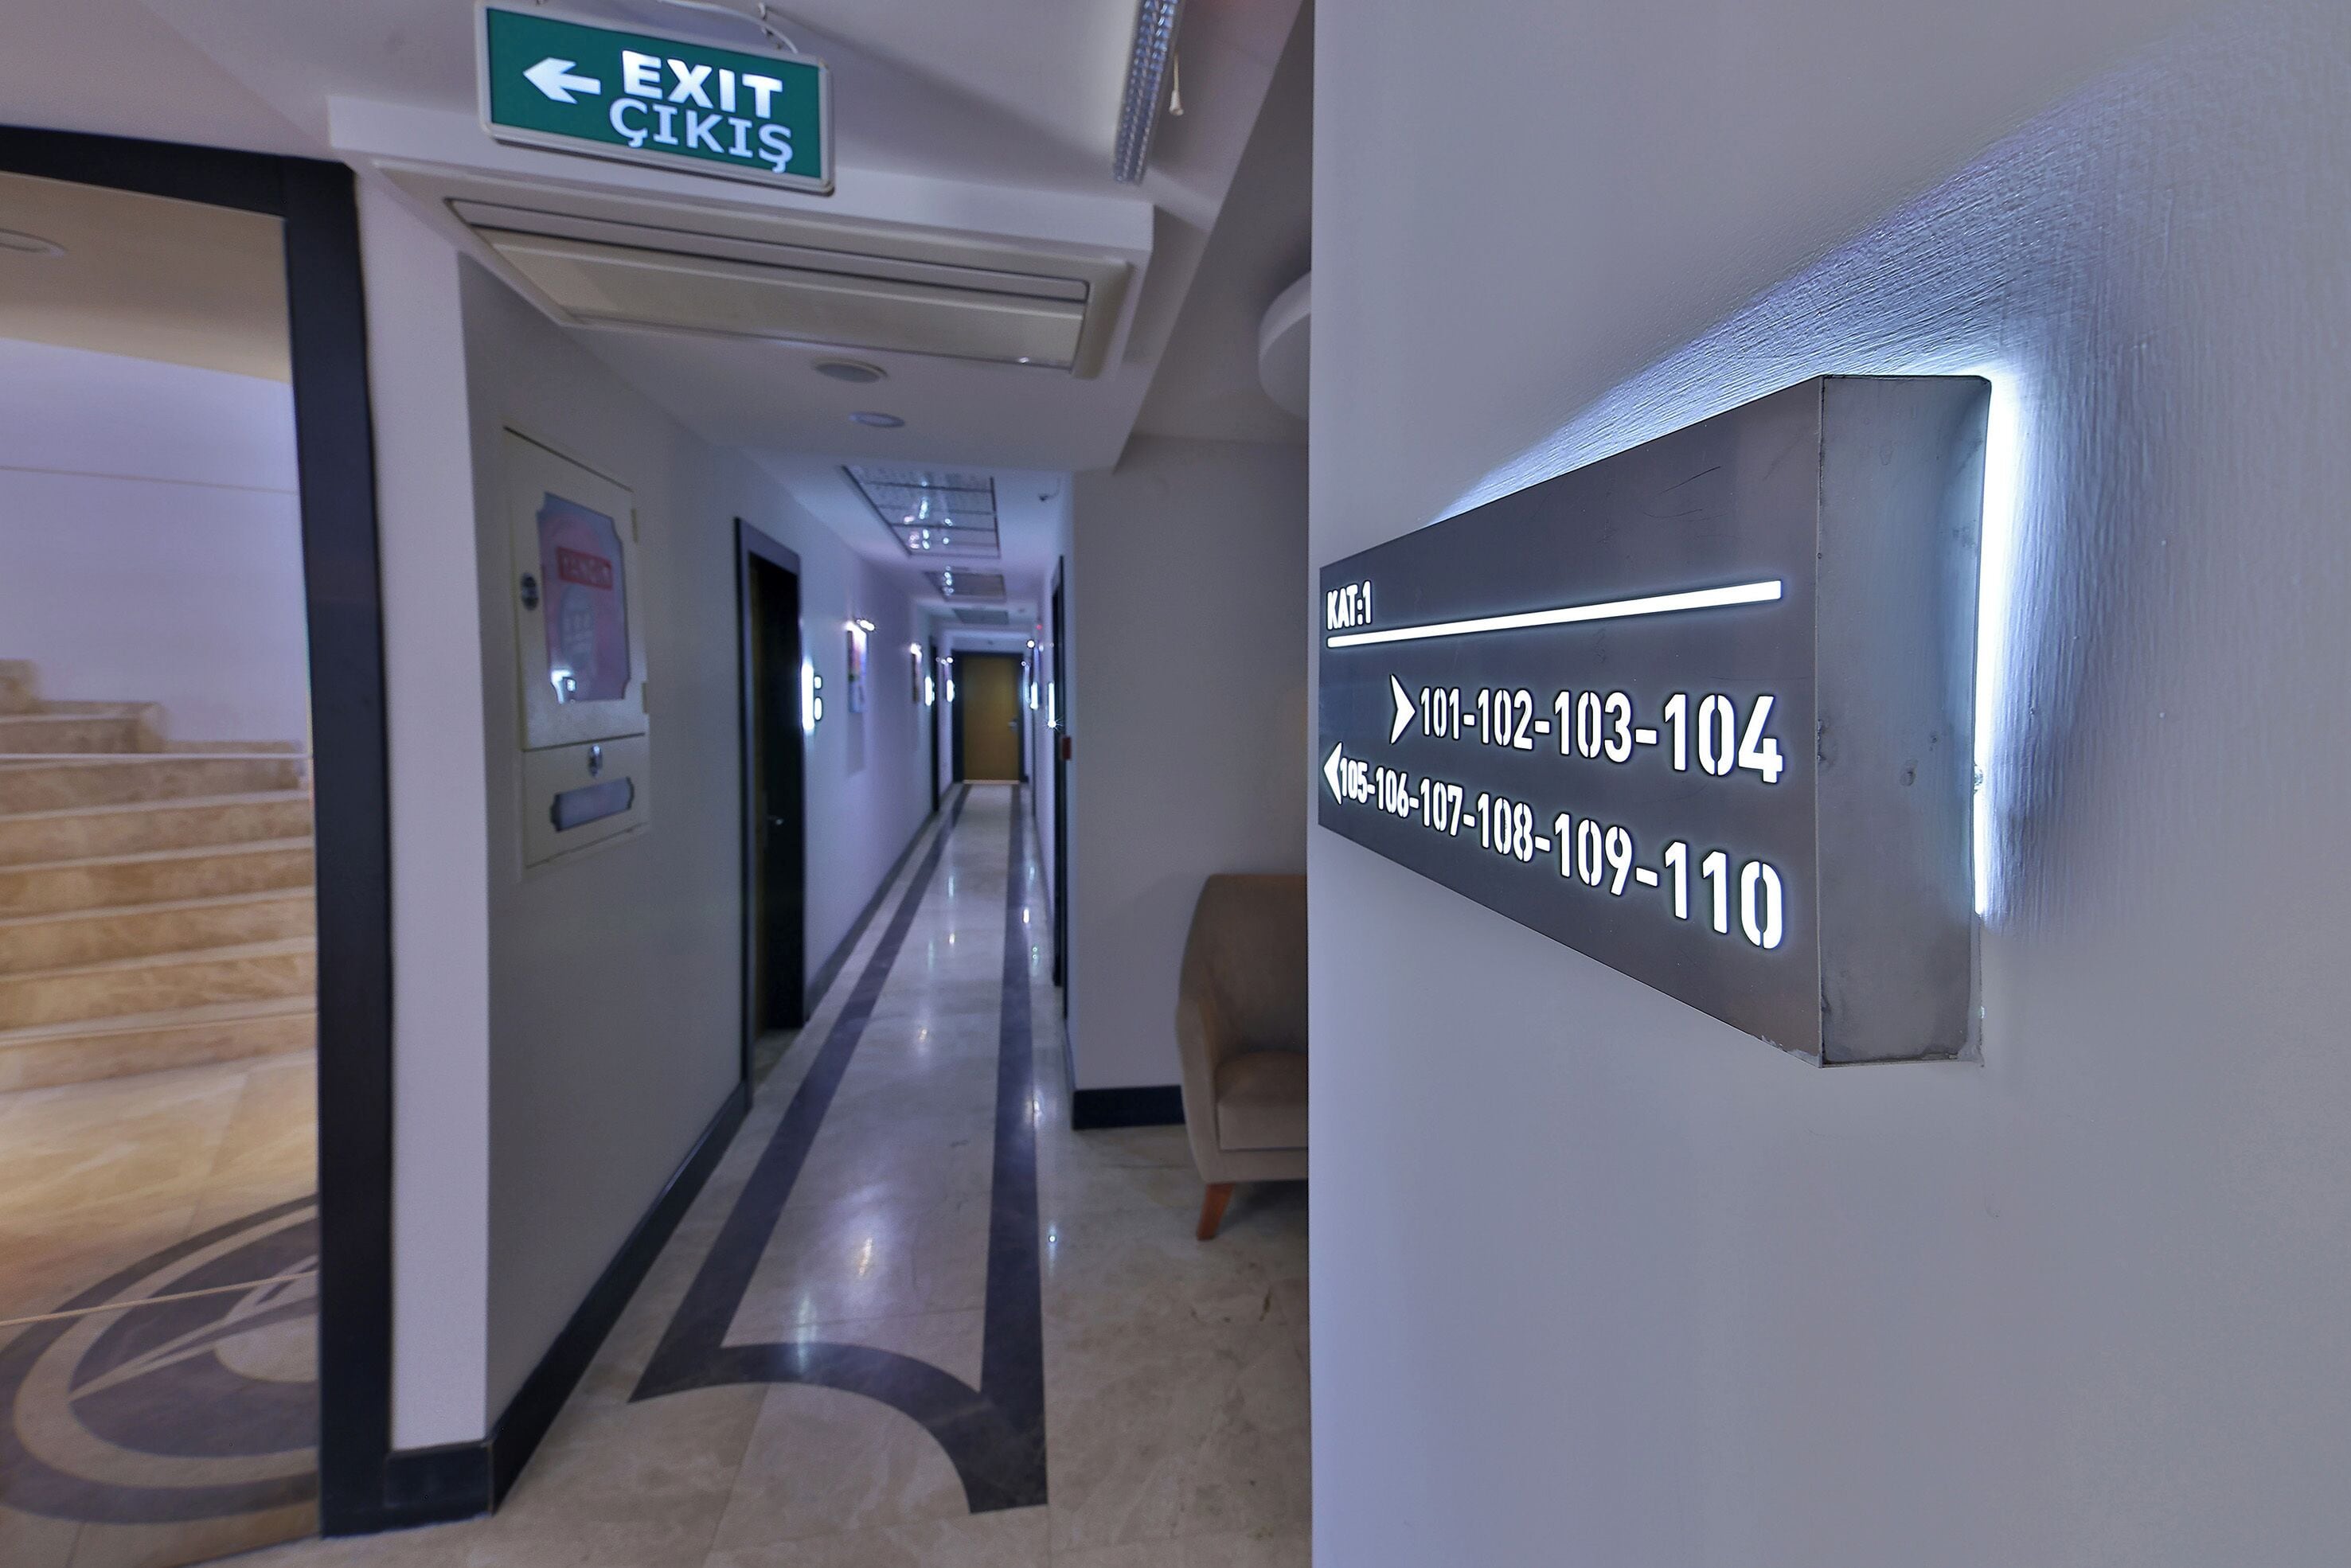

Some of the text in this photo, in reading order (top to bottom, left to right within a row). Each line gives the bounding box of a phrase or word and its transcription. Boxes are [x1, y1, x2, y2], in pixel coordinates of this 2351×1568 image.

[622, 49, 783, 119] EXIT
[609, 97, 794, 174] ÇIKIŞ
[1326, 579, 1372, 630] KAT:1
[1420, 687, 1784, 784] 101-102-103-104
[1339, 757, 1783, 950] 105-106-107-108-109-110
